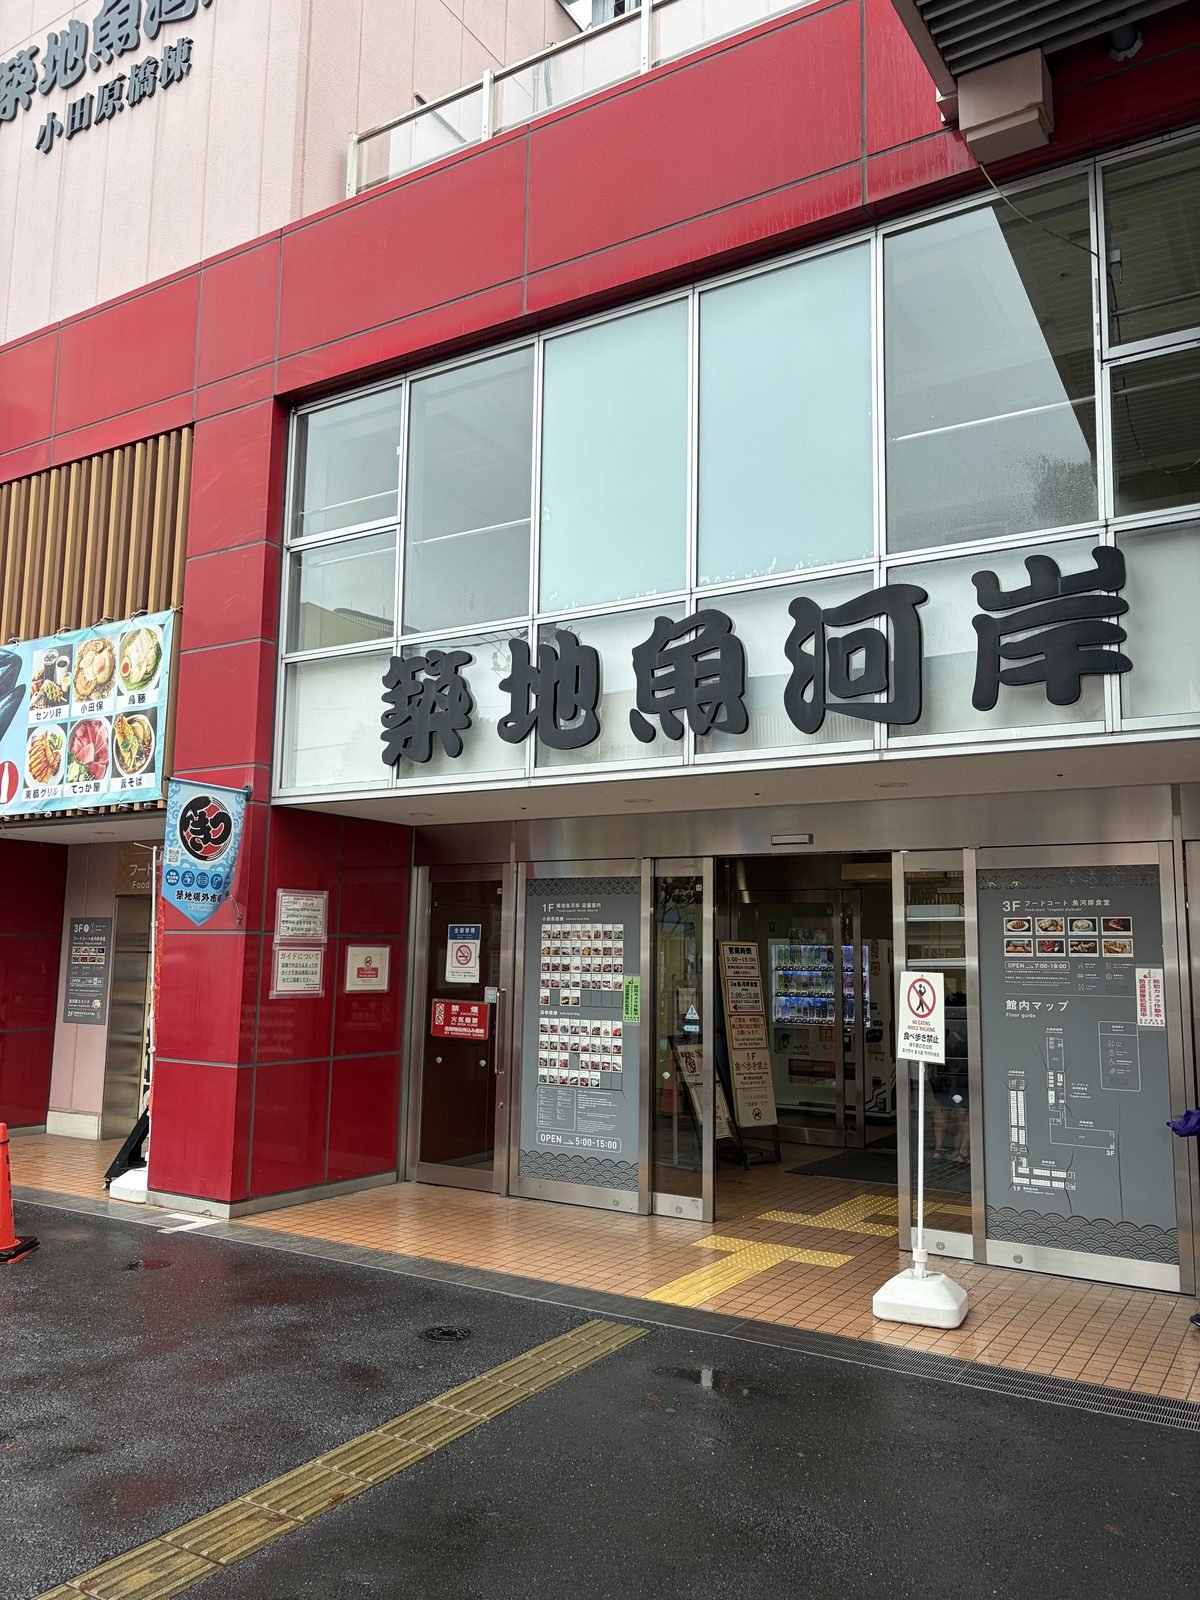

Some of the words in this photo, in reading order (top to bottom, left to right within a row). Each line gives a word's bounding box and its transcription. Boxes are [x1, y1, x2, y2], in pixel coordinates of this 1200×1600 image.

[35, 36, 193, 154] 小田原橋棟
[381, 546, 1132, 767] 築地魚河岸
[81, 701, 104, 713] 小田保
[36, 708, 62, 720] センリ軒
[25, 787, 59, 800] 東都グリル
[71, 782, 101, 794] てっか屋
[542, 903, 554, 912] 1F
[1003, 901, 1021, 912] 3F
[73, 924, 84, 933] 3F
[280, 952, 320, 960] ガイドについて
[1006, 1000, 1069, 1011] 館内マップ
[903, 1031, 939, 1044] 食べ歩き禁止
[735, 1061, 769, 1071] 食べ歩き禁止
[540, 1133, 562, 1144] OPEN
[575, 1139, 617, 1150] 5:00-15:00
